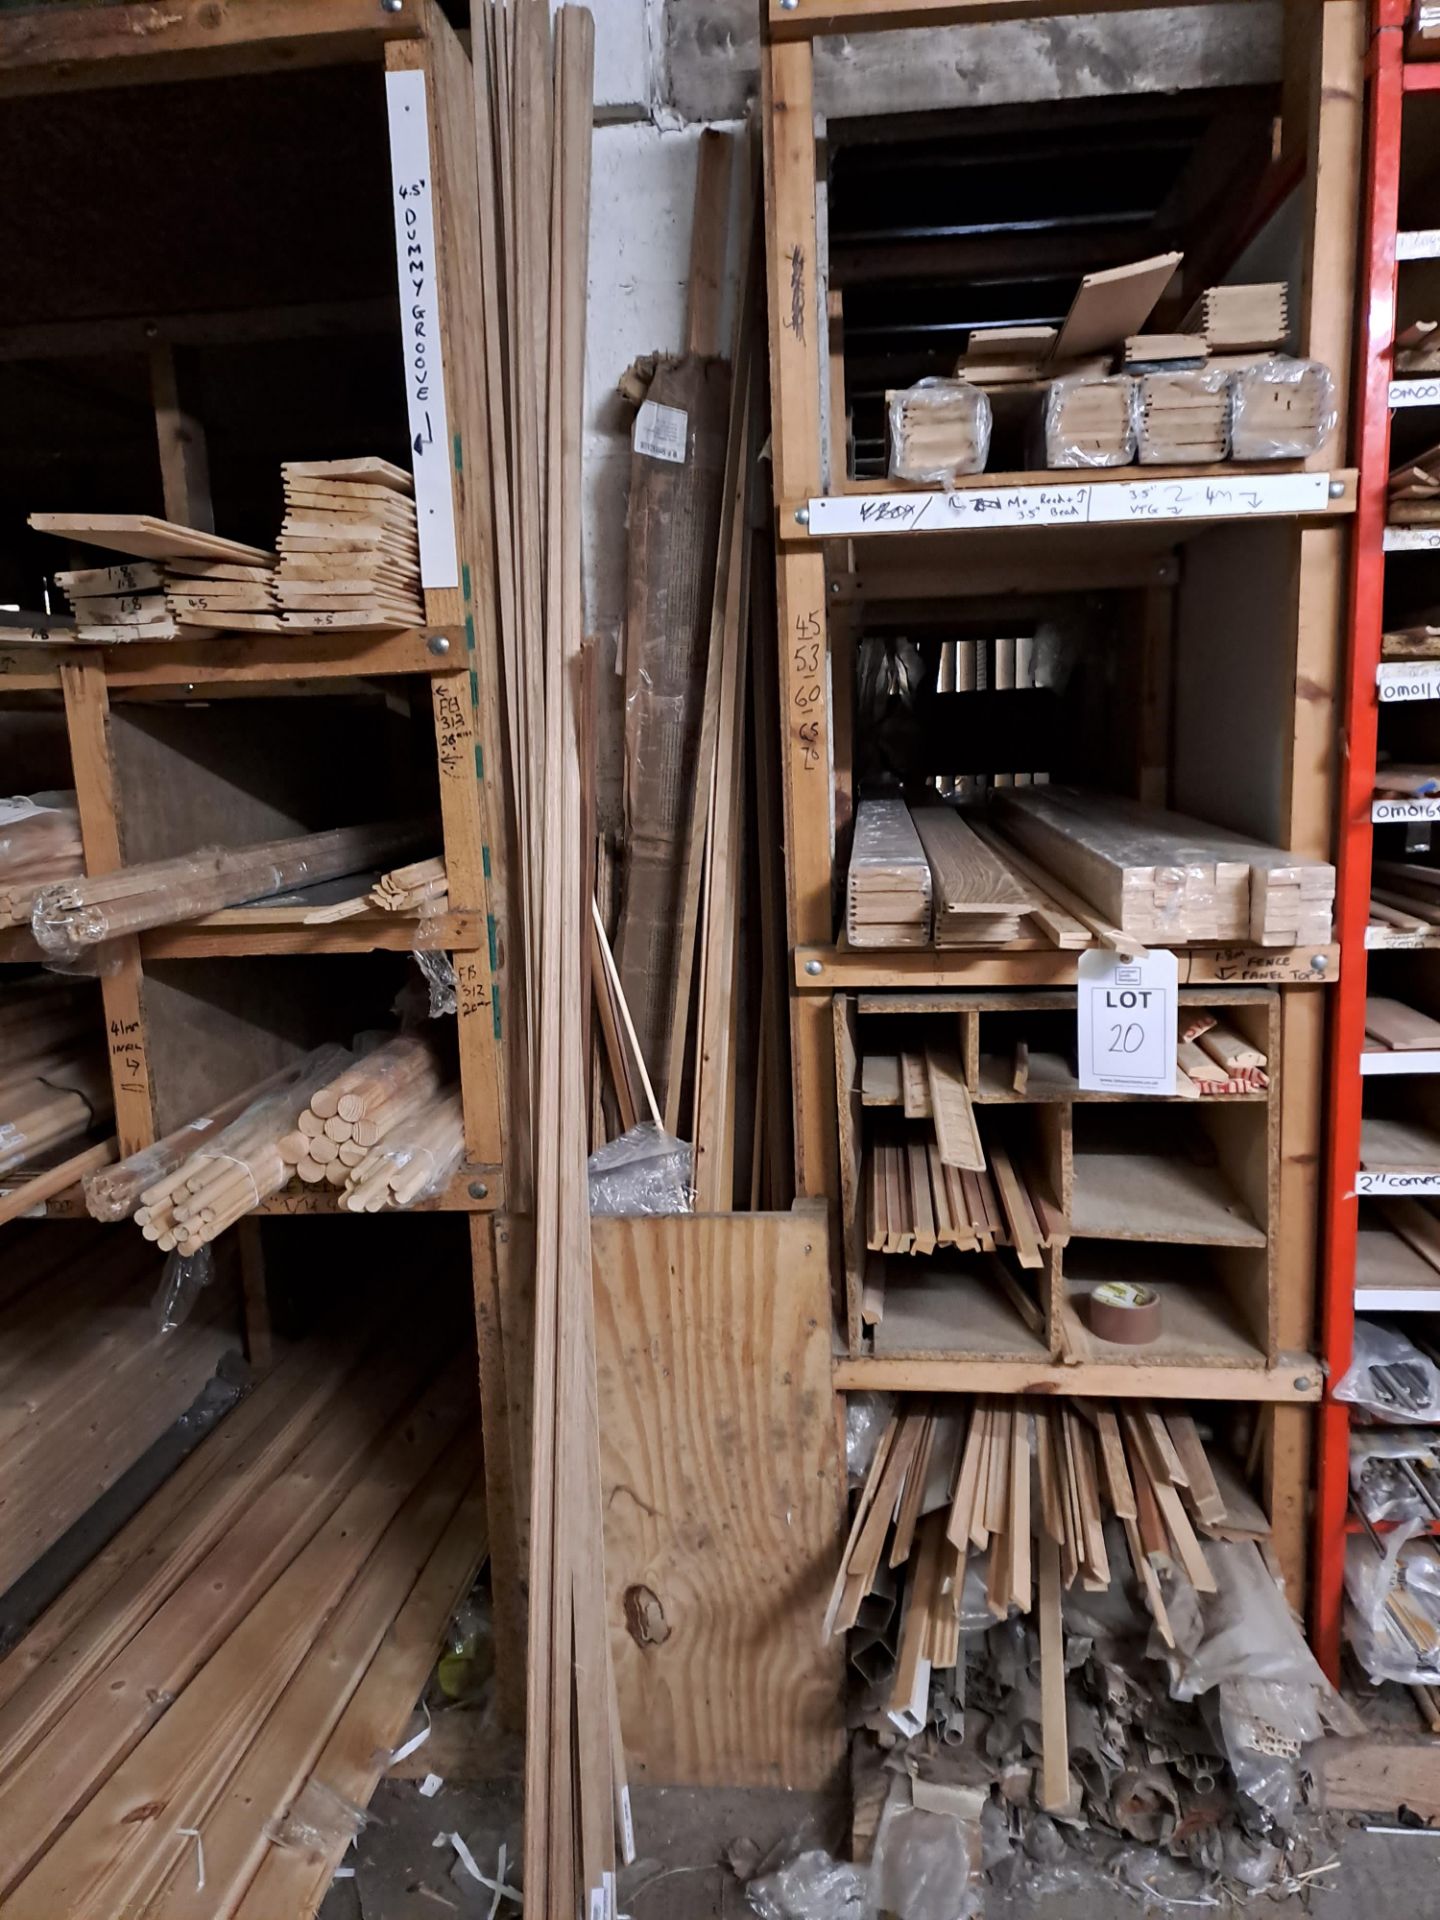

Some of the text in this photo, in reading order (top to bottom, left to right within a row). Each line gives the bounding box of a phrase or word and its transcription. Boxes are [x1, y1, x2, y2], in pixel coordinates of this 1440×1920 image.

[405, 208, 424, 297] DUMMY
[412, 305, 429, 400] GROOVE
[796, 610, 821, 636] 45
[794, 643, 820, 672] 53
[794, 684, 821, 708] 60
[1242, 969, 1327, 981] PANEL TOPS
[1247, 957, 1291, 967] FENCE
[1106, 990, 1152, 1009] LOT
[1108, 1022, 1145, 1054] 20
